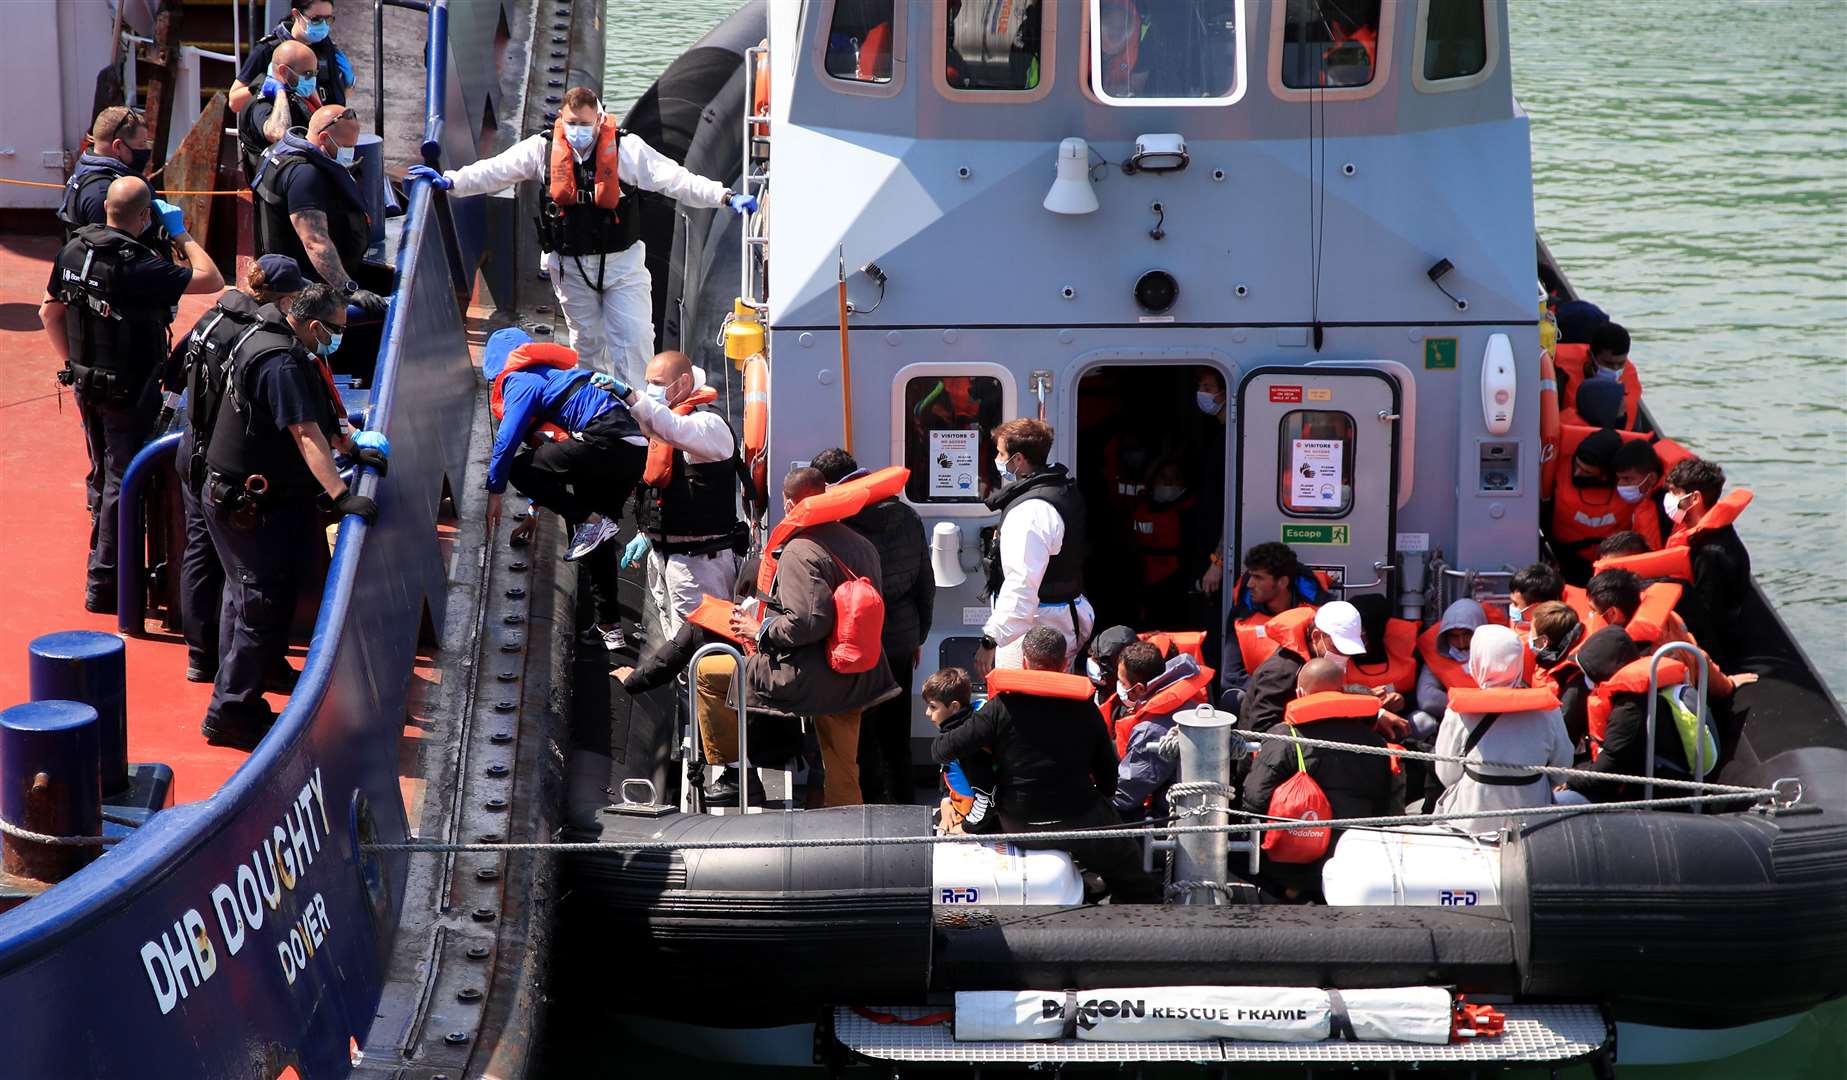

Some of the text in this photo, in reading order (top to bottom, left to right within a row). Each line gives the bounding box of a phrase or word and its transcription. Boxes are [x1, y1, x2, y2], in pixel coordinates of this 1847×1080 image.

[1287, 528, 1322, 538] Escape
[140, 767, 330, 1015] DHB DOUGHTY
[942, 887, 978, 903] RFD
[1441, 890, 1477, 905] RFD
[276, 892, 331, 988] DOVER
[1152, 1006, 1230, 1020] RESCUE
